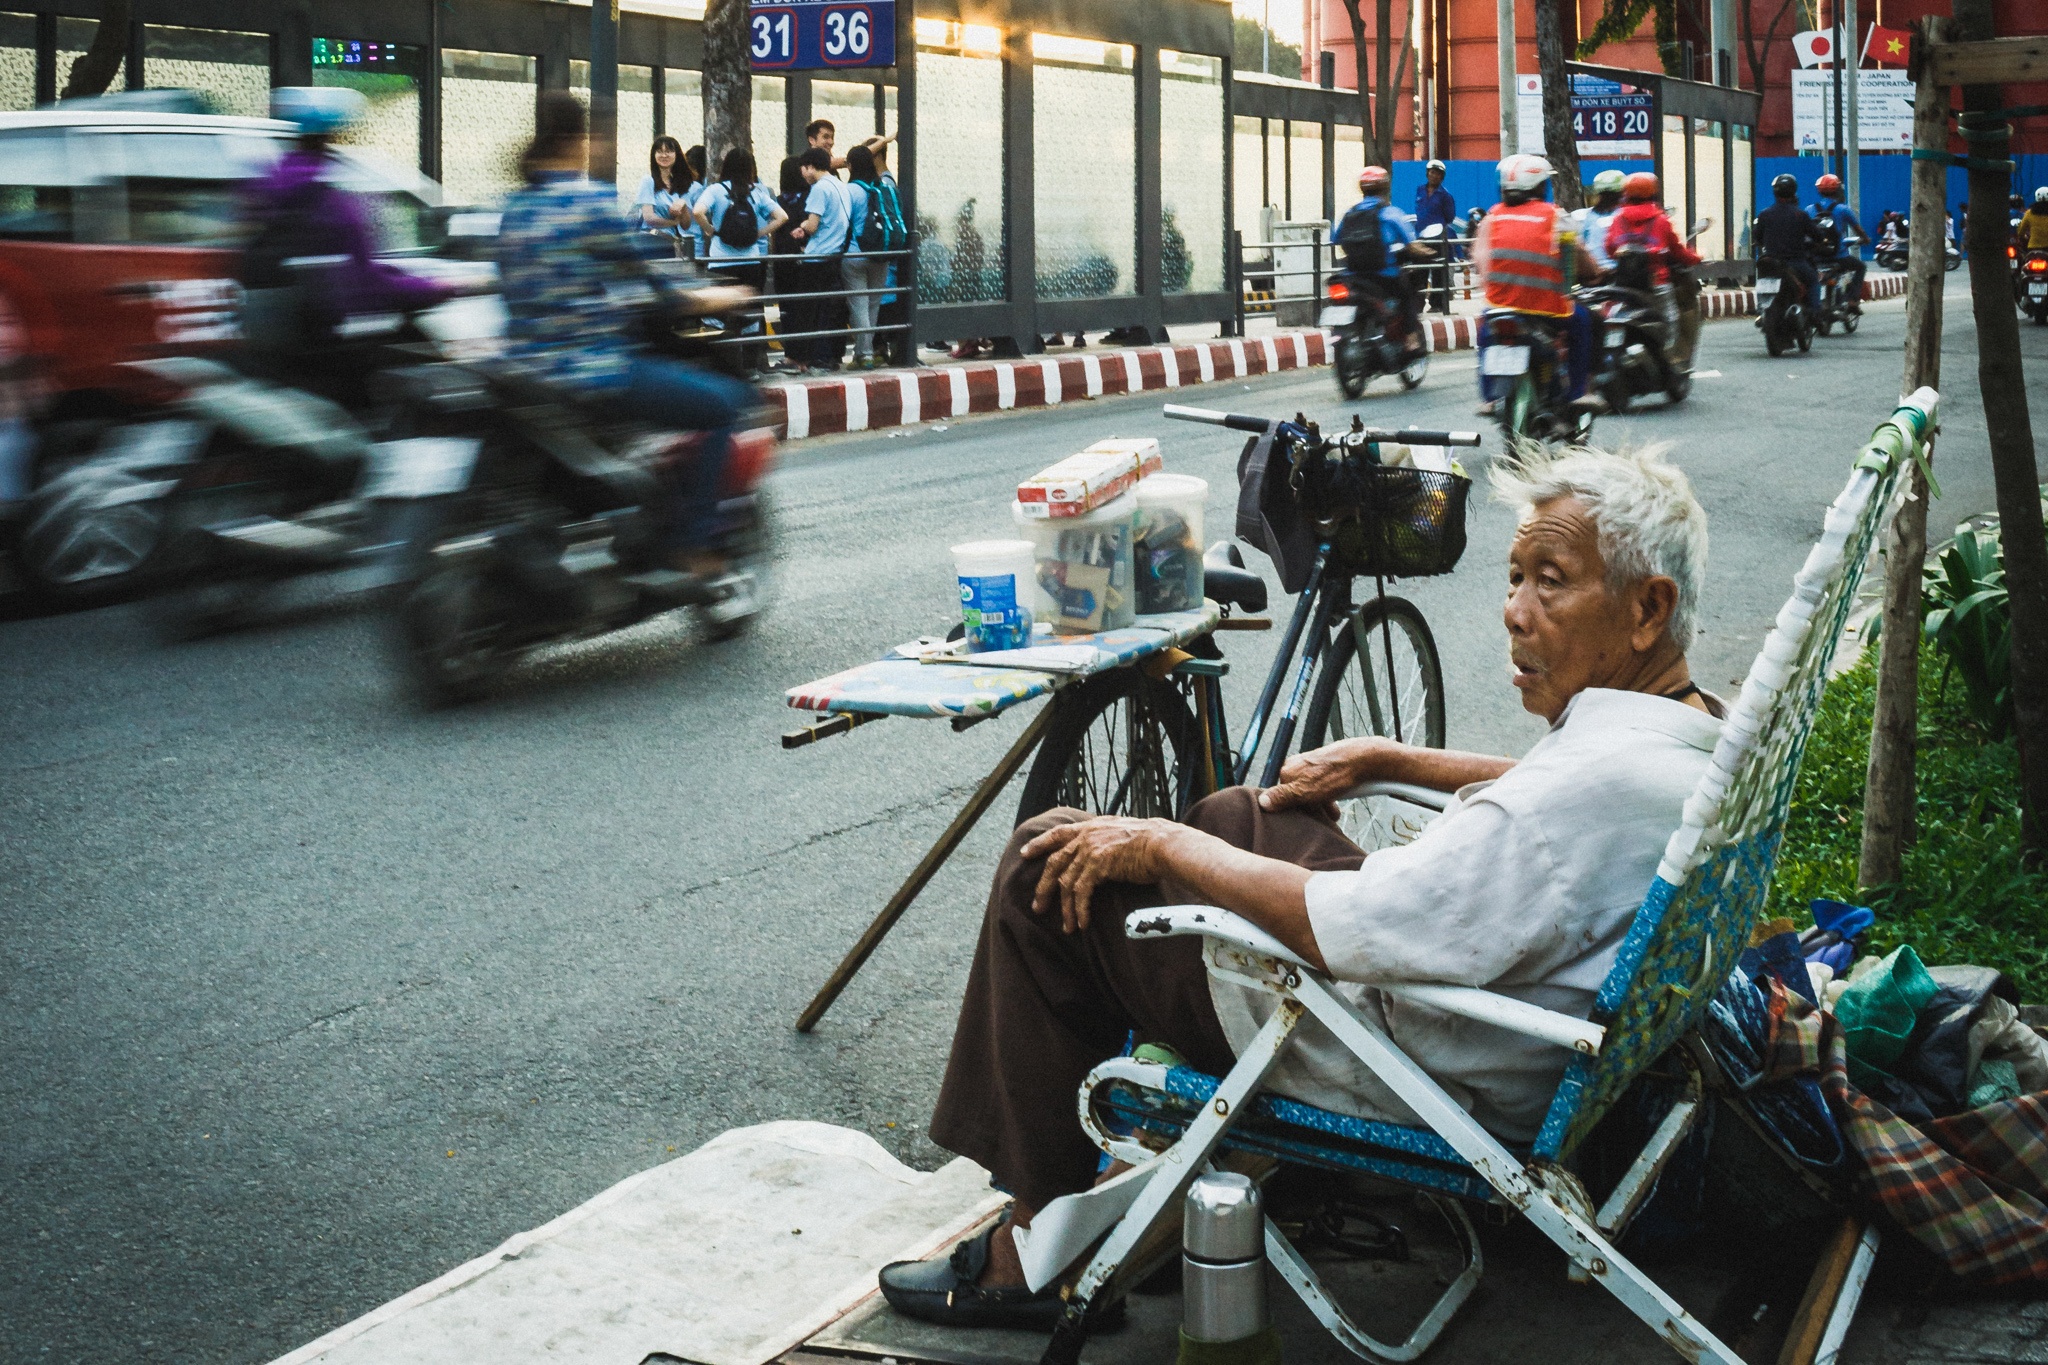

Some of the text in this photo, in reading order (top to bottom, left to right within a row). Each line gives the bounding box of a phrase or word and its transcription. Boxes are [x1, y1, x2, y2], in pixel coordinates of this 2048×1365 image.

[751, 11, 870, 58] 31 36
[1592, 112, 1617, 134] 18
[1624, 111, 1648, 133] 20
